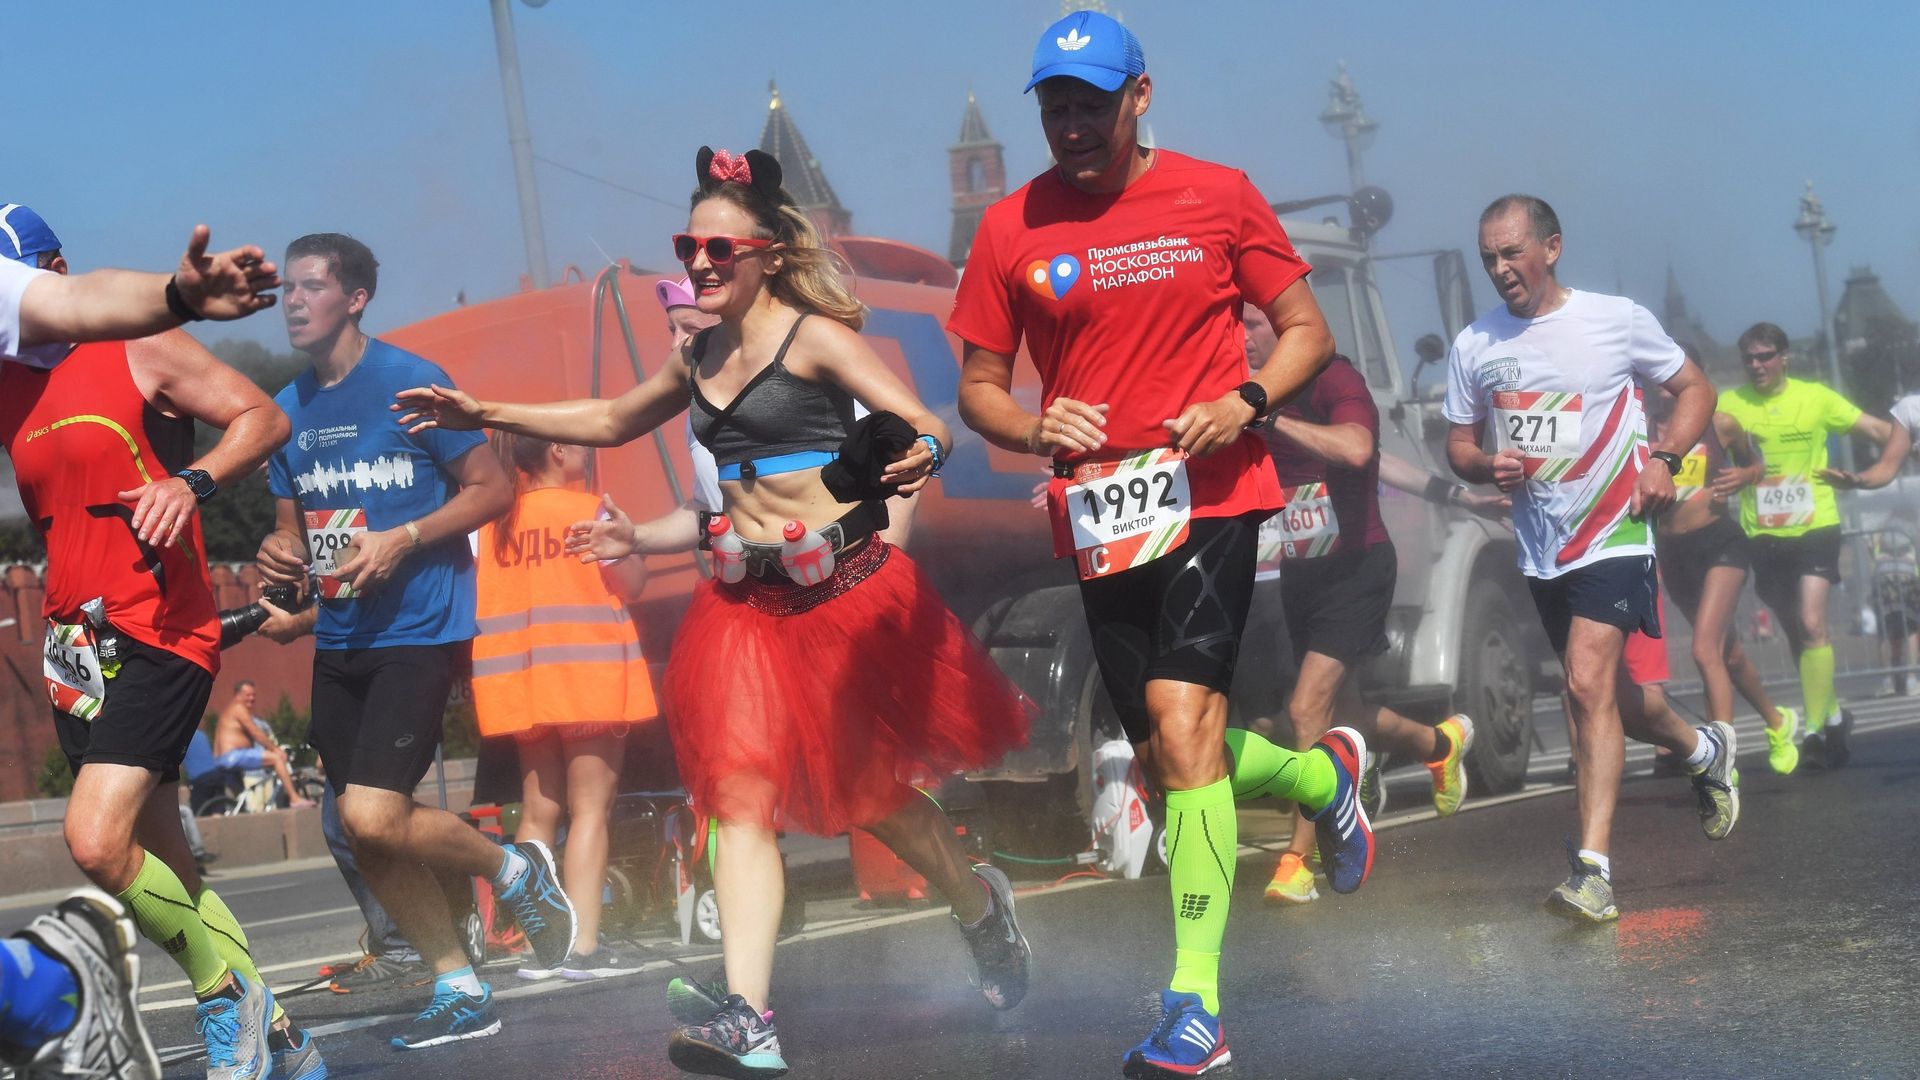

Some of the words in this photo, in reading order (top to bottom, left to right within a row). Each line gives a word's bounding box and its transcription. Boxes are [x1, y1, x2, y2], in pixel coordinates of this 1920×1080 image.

[1087, 235, 1190, 261] Промсвязьбанк
[1089, 247, 1204, 276] МОСКОВСКИЙ
[1092, 266, 1175, 292] МАРАФОН
[318, 424, 358, 435] МУЗЫКАЛЬНЫЙ
[1508, 415, 1557, 443] 271
[1083, 471, 1178, 525] 1992
[1763, 487, 1806, 506] 4969
[1112, 515, 1156, 535] ВИКТОР
[1091, 546, 1111, 574] C
[1180, 910, 1204, 921] cep
